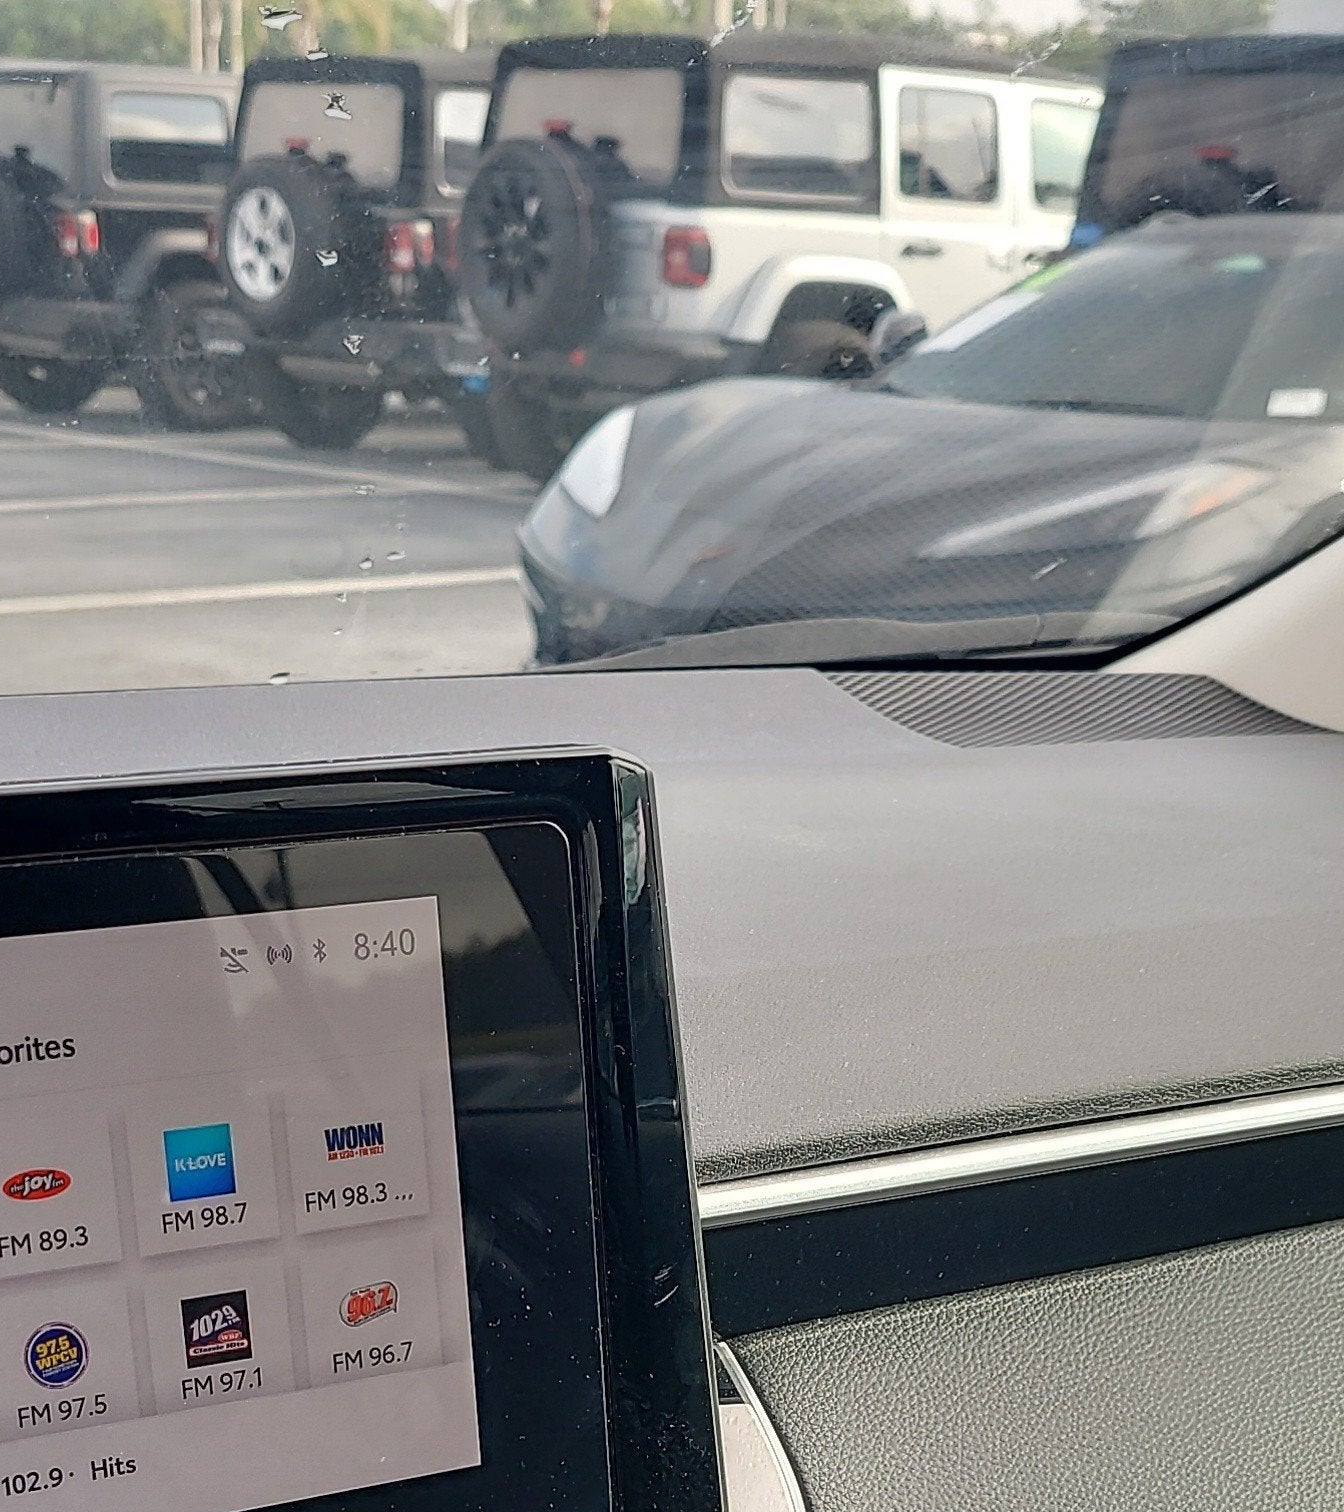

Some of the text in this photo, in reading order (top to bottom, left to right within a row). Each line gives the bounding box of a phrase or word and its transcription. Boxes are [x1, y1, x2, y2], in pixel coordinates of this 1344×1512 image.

[353, 928, 417, 961] 8:40
[324, 1122, 384, 1152] WONN
[305, 1189, 336, 1213] FM
[343, 1182, 387, 1207] 98.3
[161, 1202, 247, 1234] FM 98.7
[39, 1226, 89, 1251] 89.3
[36, 1335, 70, 1358] 97.5
[333, 1341, 413, 1374] FM 96.7
[182, 1367, 263, 1399] FM 97.1
[17, 1393, 107, 1428] FM 97.5
[0, 1456, 137, 1496] 102.9 Hits
